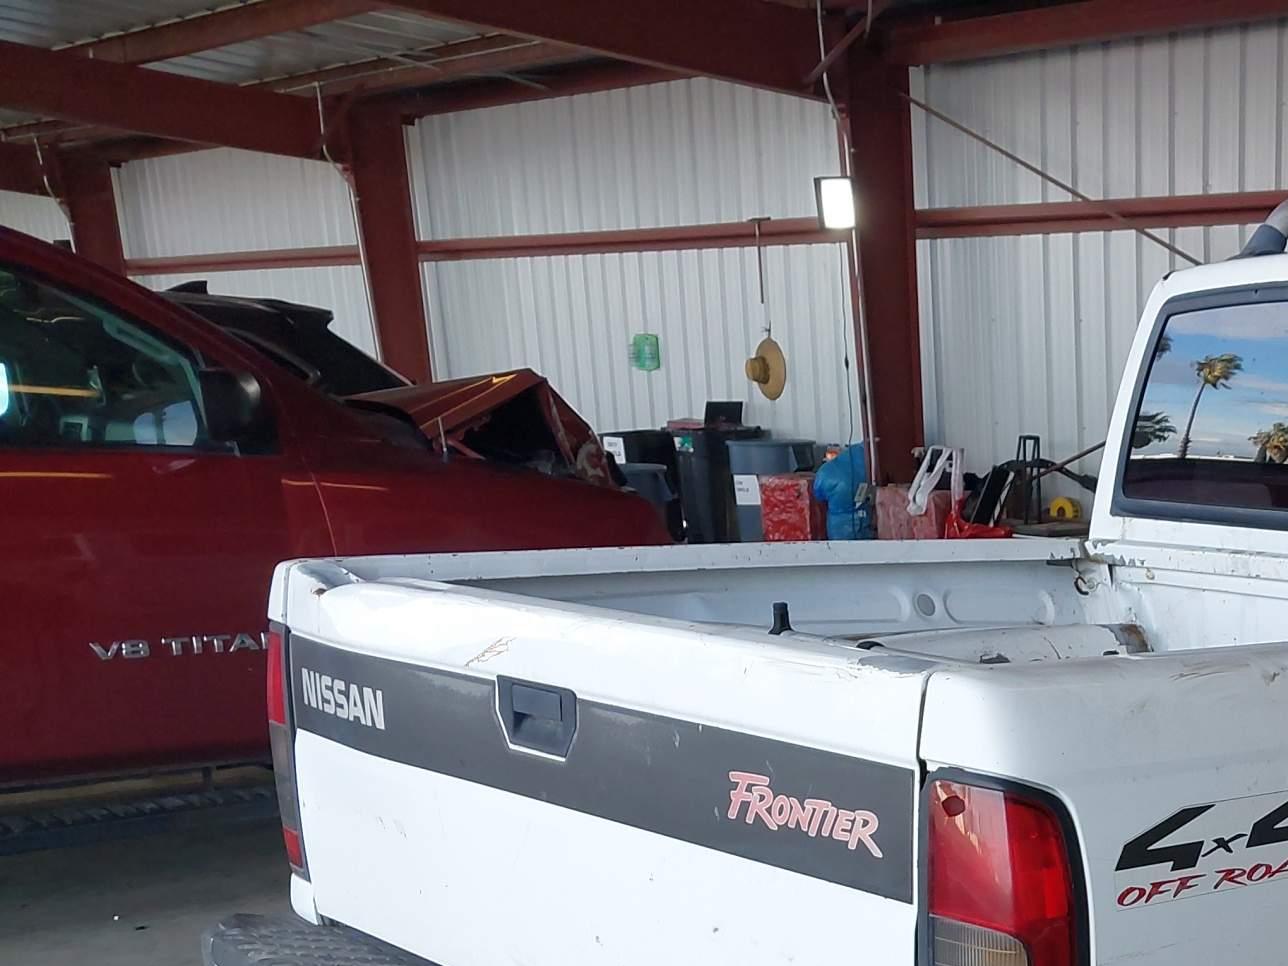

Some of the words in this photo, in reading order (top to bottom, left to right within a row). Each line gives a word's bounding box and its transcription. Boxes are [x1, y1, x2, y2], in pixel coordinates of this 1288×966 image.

[88, 639, 150, 660] V8
[301, 667, 386, 730] NISSAN
[727, 770, 884, 858] FRONTIER
[1115, 873, 1207, 908] OFF
